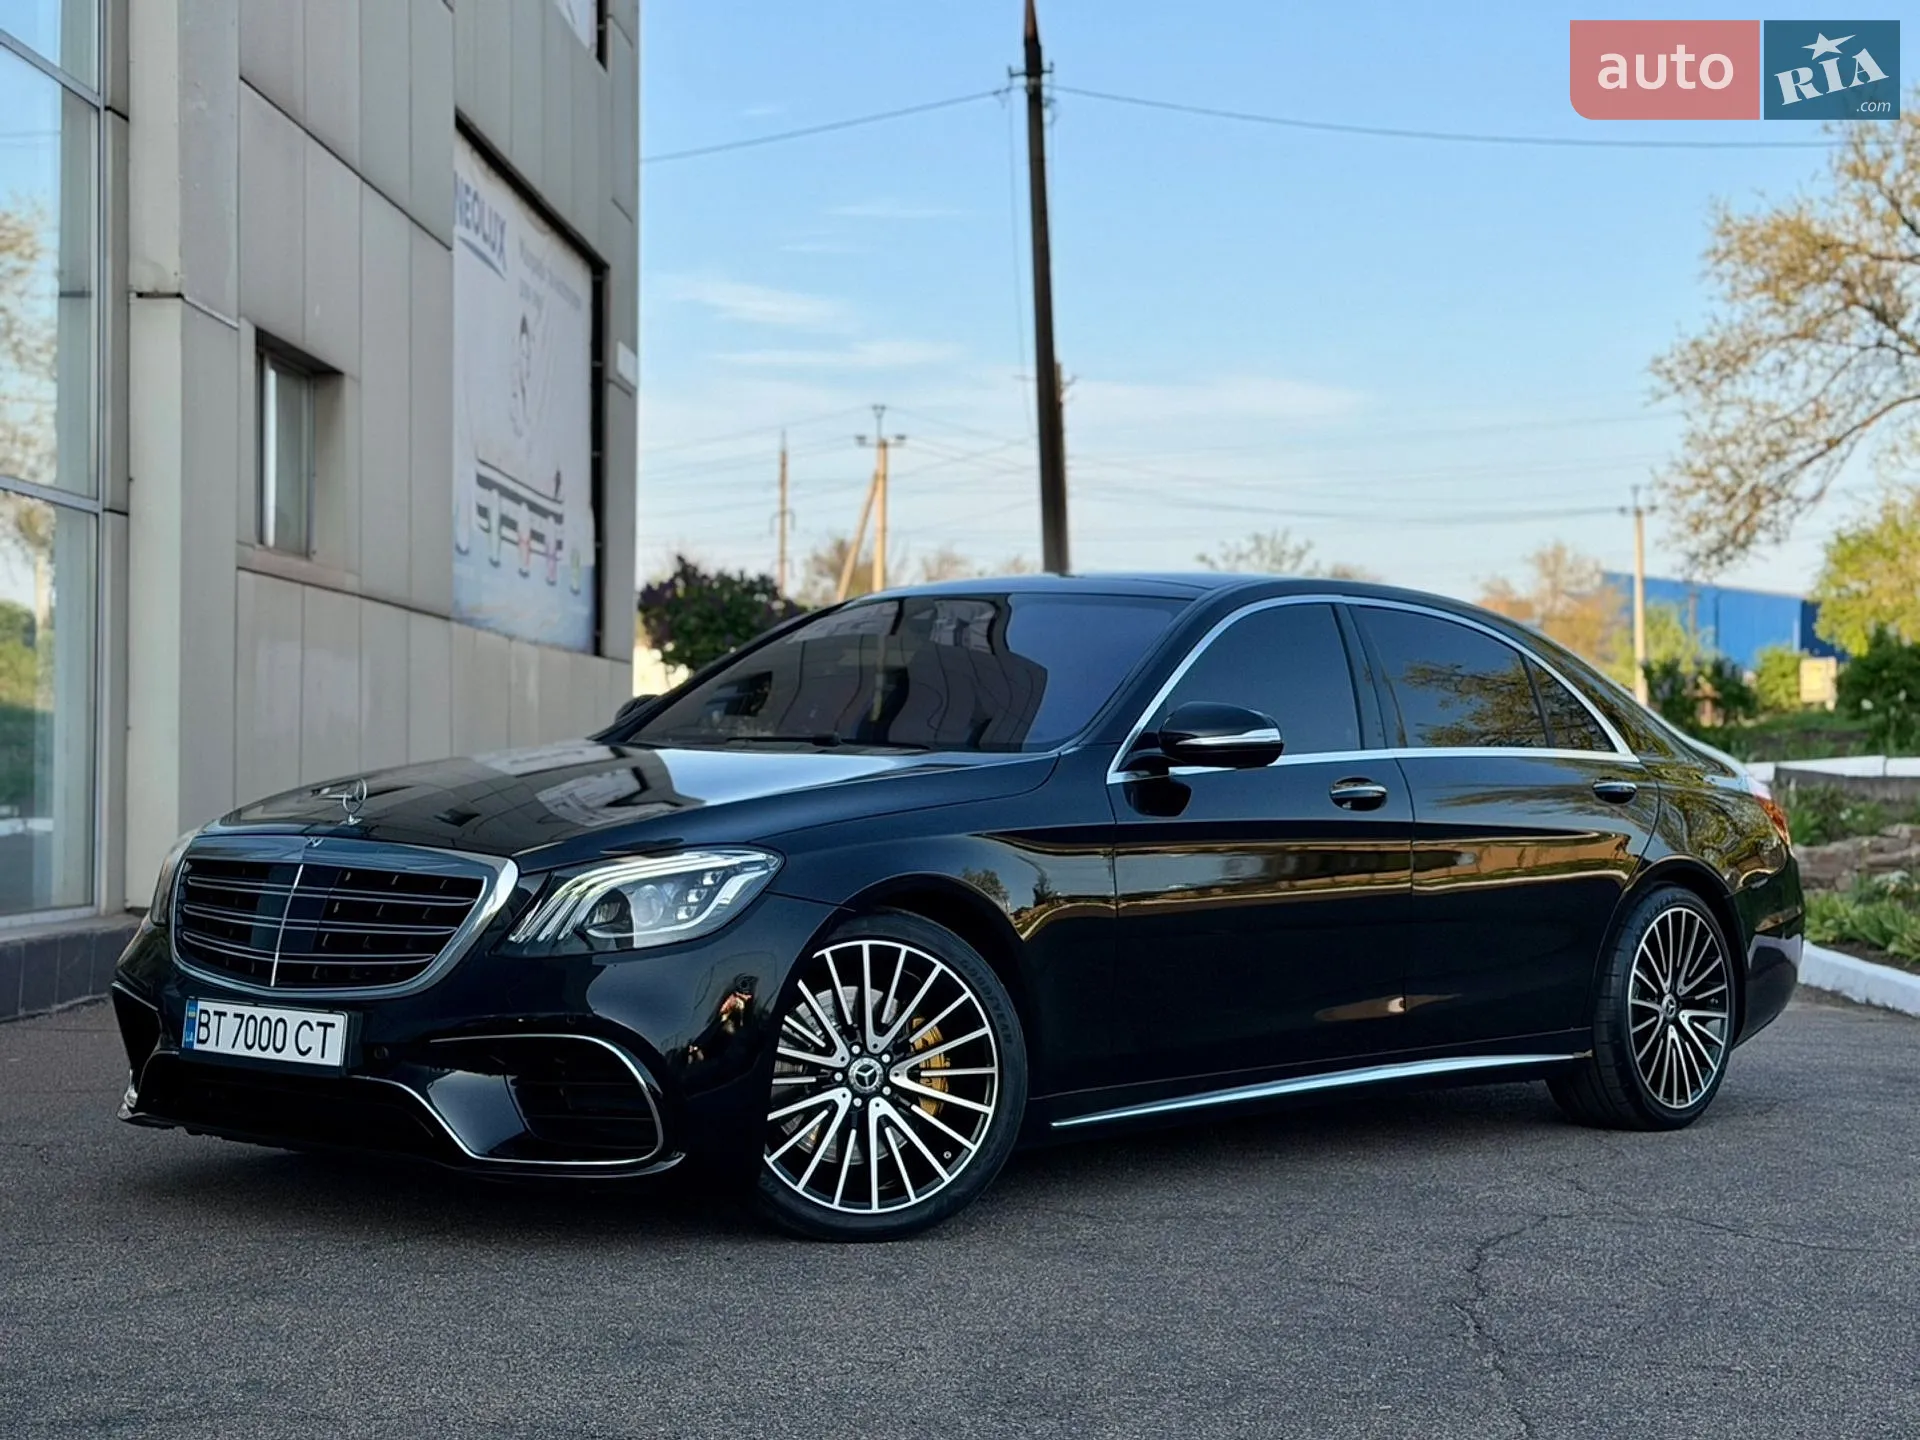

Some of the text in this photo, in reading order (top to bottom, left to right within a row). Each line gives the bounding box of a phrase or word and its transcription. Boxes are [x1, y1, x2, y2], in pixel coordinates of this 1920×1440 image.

[453, 169, 508, 273] NEOLUX
[196, 1009, 336, 1059] BT 7000 CT
